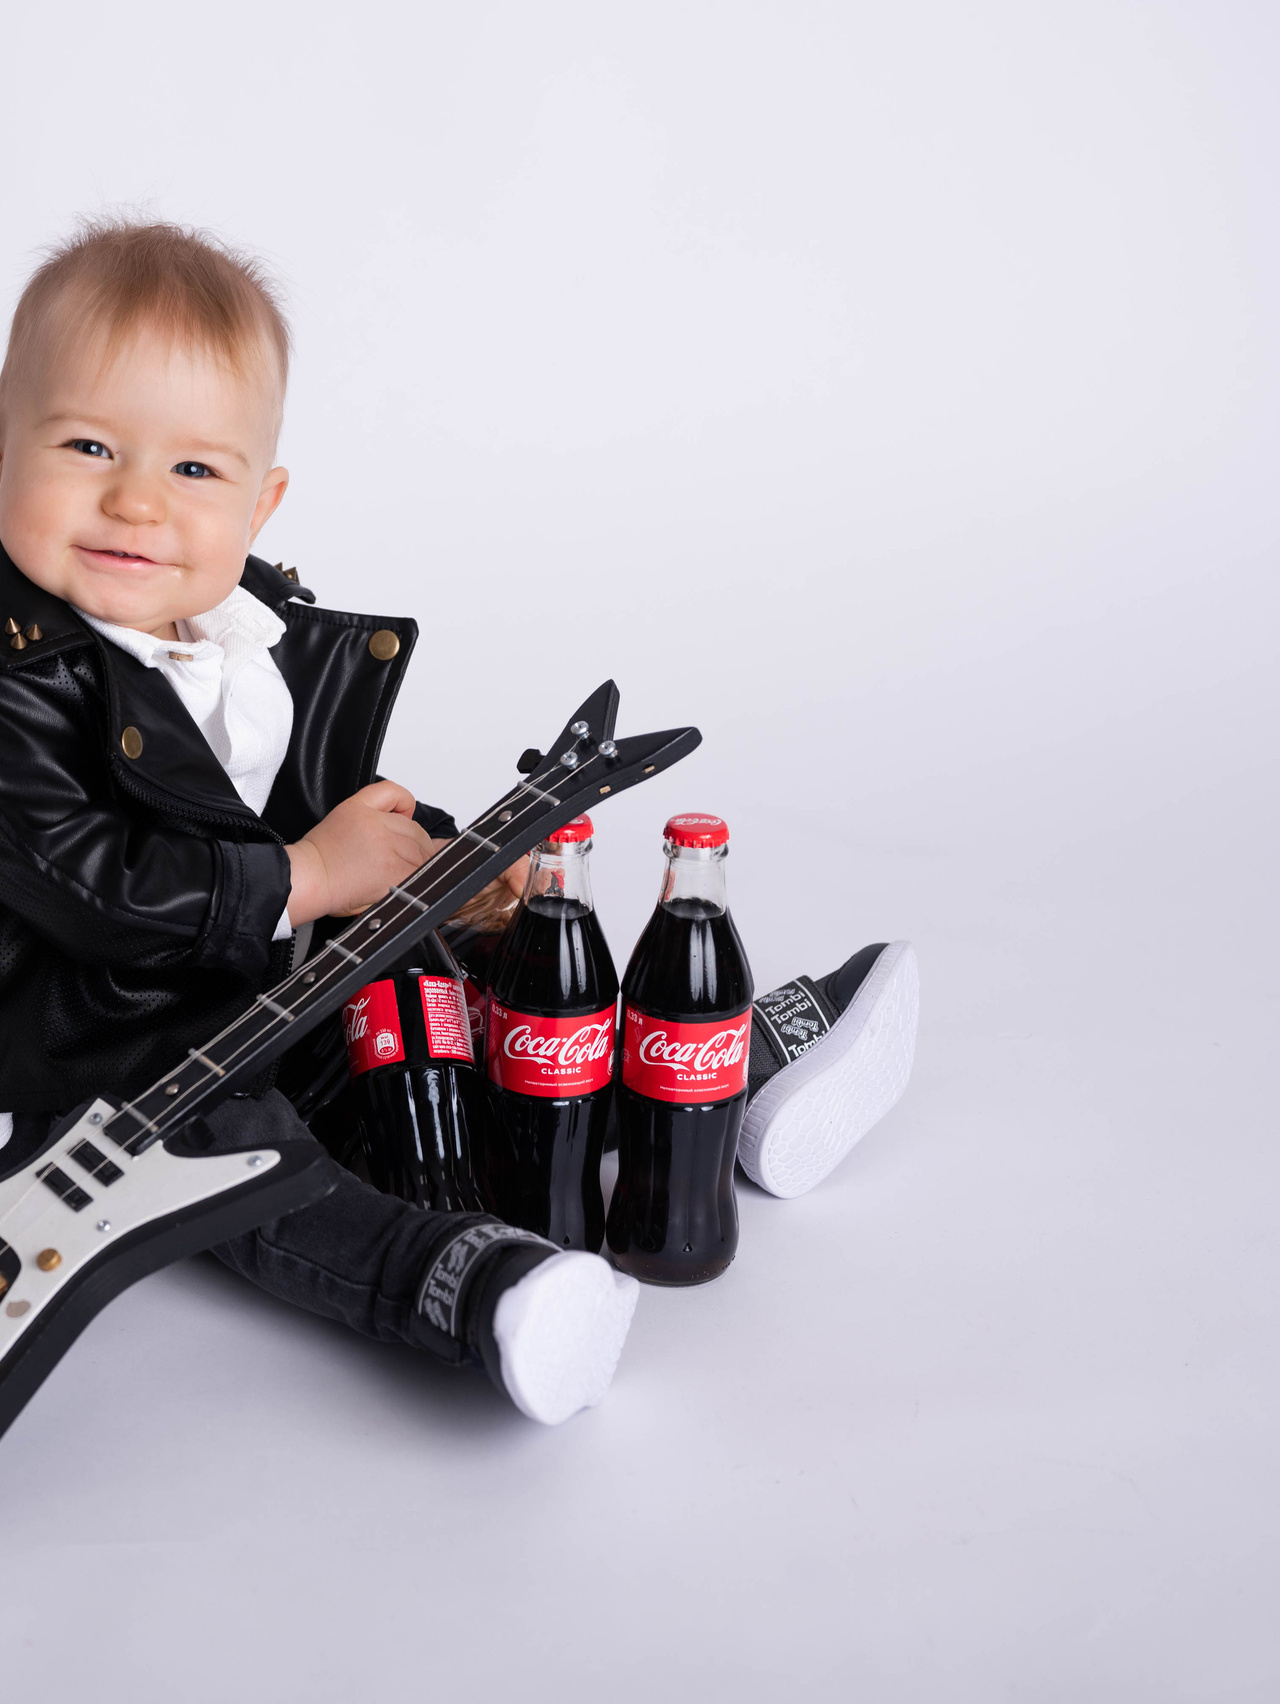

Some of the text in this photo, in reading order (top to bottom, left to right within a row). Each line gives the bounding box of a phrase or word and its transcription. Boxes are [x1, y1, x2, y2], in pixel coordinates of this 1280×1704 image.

[765, 990, 806, 1015] Tombi
[771, 999, 812, 1025] Tombi
[504, 1016, 613, 1066] Coca-Cola
[639, 1021, 748, 1072] Coca-Cola
[541, 1066, 581, 1075] CLASSIC
[676, 1072, 717, 1081] CLASSIC
